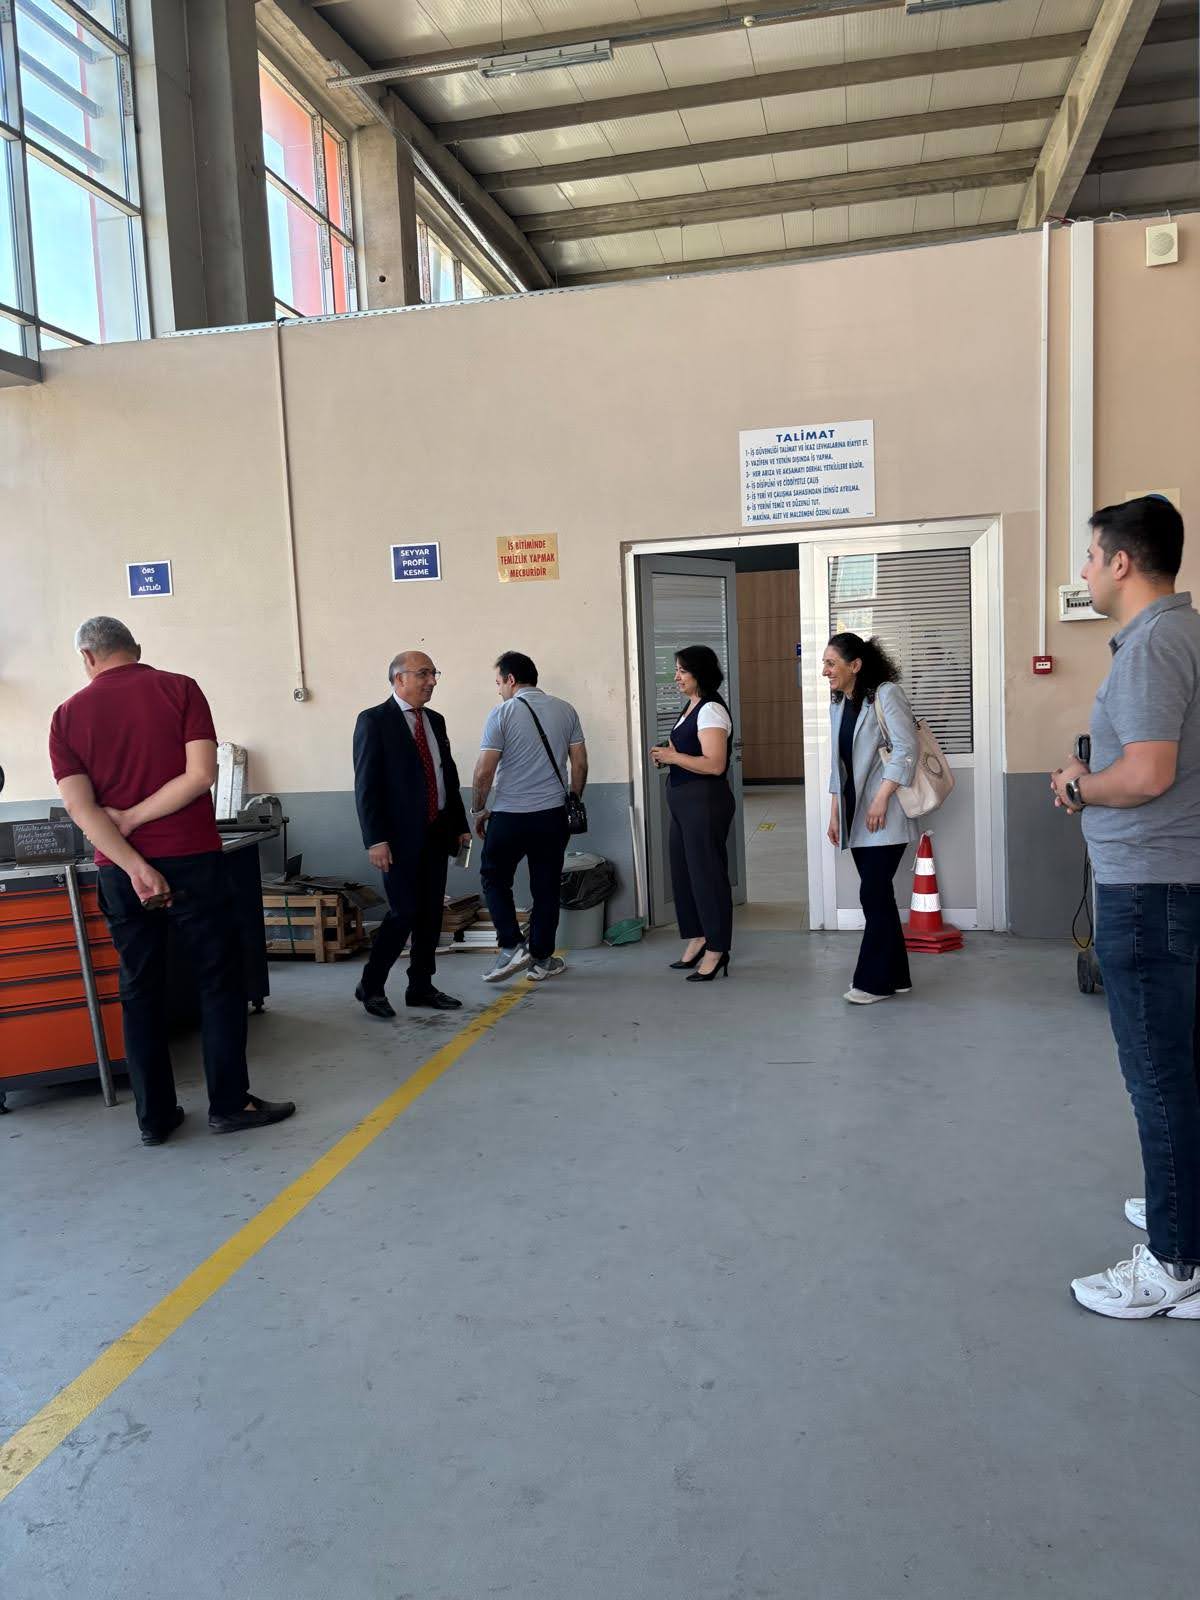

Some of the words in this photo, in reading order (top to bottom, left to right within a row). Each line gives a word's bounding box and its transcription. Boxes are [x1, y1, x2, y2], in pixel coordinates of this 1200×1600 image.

[776, 430, 834, 442] TALİMAT
[780, 444, 797, 453] TALİMAT
[515, 538, 546, 550] BİTİMİNDE
[400, 548, 430, 557] SEYYAR
[402, 556, 429, 567] PROFİL
[500, 553, 528, 565] TEMİZLİK
[529, 553, 555, 562] YAPMAK
[510, 566, 546, 578] MECBURİDİR
[138, 584, 162, 592] ALTLIĞI
